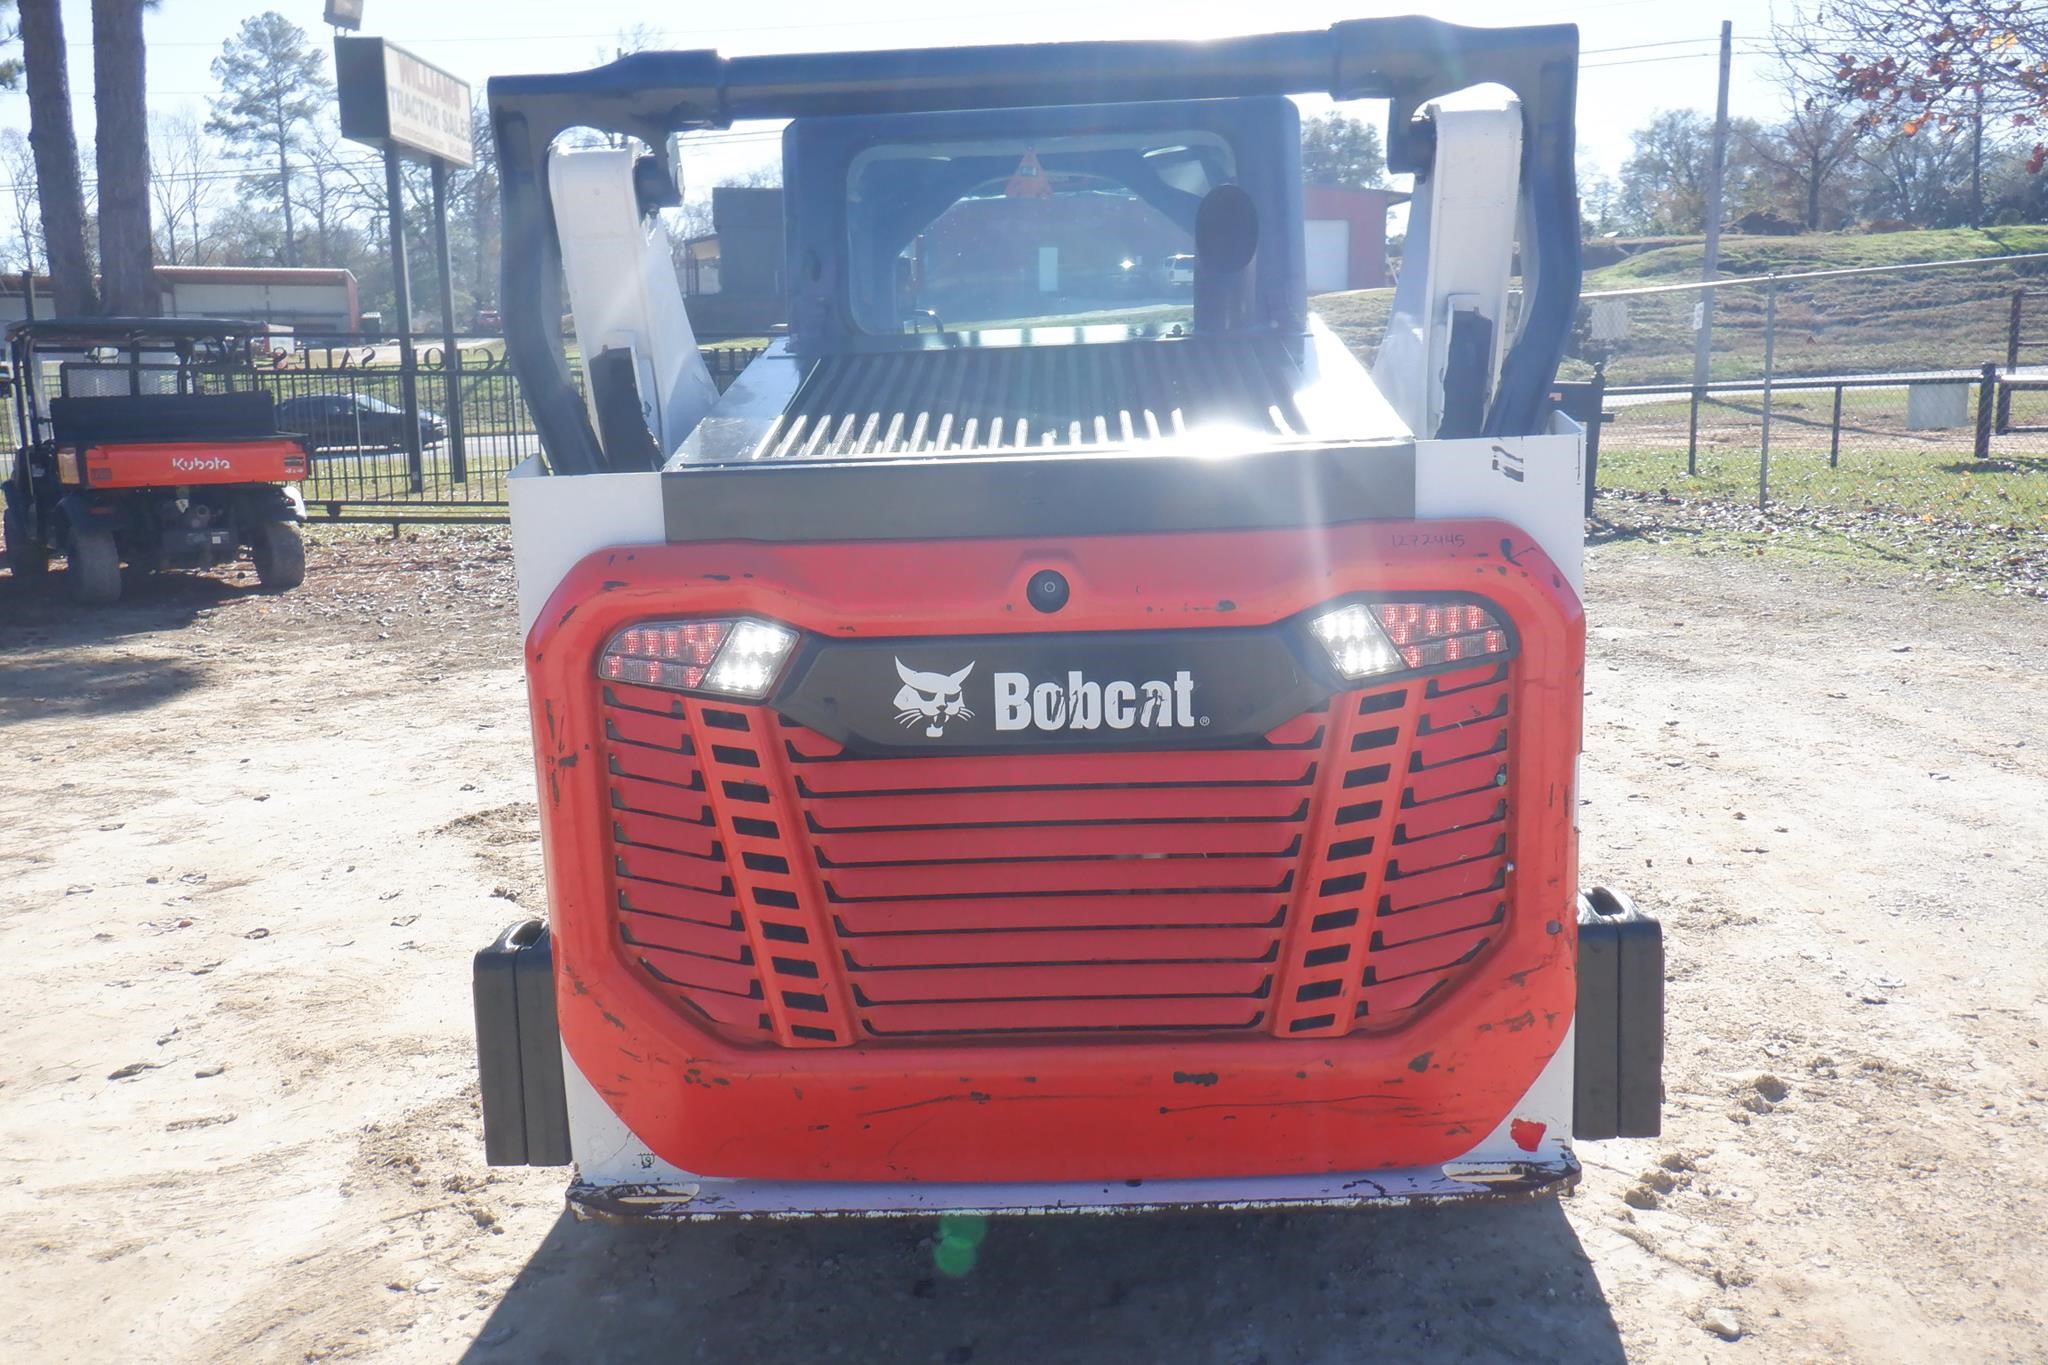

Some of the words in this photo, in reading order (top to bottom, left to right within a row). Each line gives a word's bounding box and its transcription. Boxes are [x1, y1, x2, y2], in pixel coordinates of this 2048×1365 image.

[390, 87, 440, 130] TRACTOR
[442, 109, 471, 144] SALES
[172, 457, 231, 471] Kubota
[994, 671, 1196, 731] Bobcat
